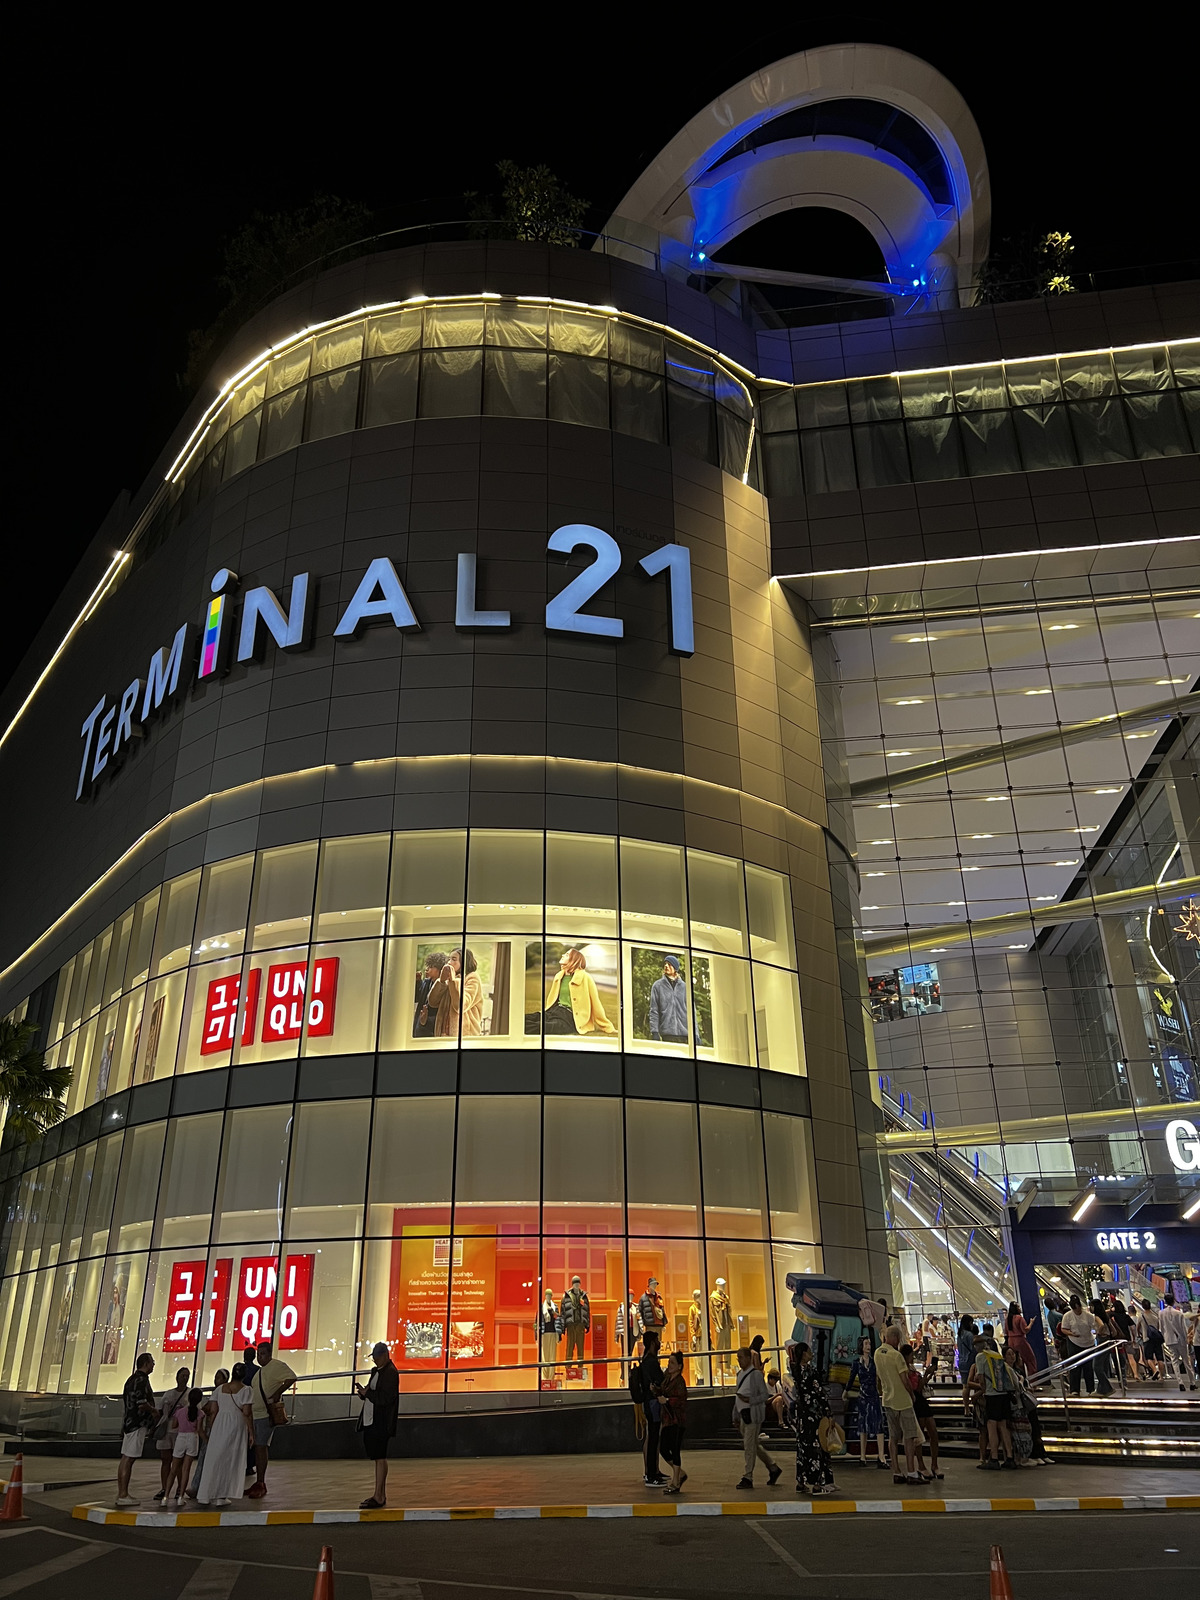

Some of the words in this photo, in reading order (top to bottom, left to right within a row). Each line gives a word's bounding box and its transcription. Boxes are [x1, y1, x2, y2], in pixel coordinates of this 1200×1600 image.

[545, 523, 695, 656] 21
[273, 967, 322, 998] UNI
[270, 999, 324, 1035] QLO
[1165, 1119, 1200, 1170] G
[1096, 1232, 1141, 1250] GATE
[1143, 1232, 1157, 1249] 2
[245, 1265, 297, 1298] UNI
[240, 1304, 298, 1344] QLO
